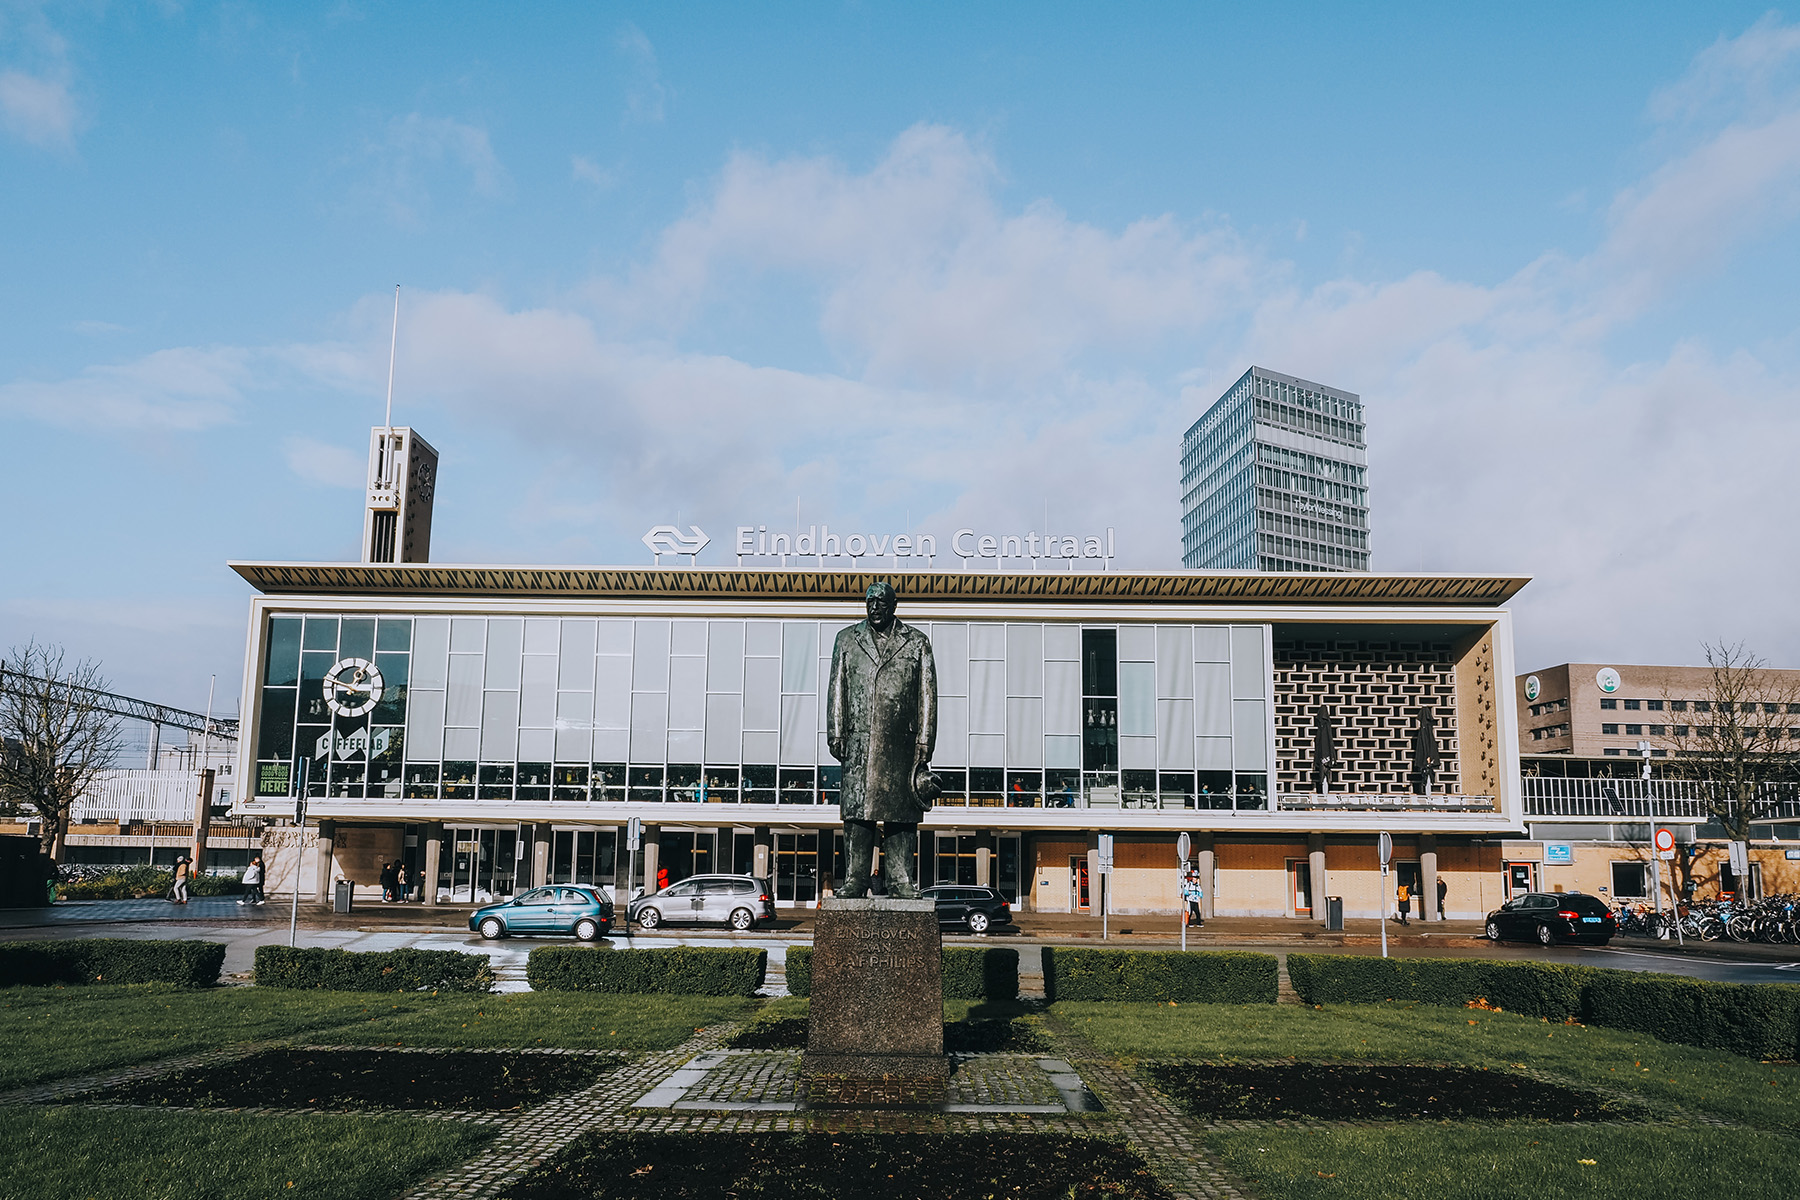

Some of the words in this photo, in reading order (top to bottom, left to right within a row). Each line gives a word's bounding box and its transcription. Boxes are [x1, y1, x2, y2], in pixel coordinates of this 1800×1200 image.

[736, 525, 936, 557] Eindhoven
[951, 527, 1115, 559] Centraal
[321, 737, 383, 750] CFFEELAB
[259, 780, 288, 792] HERE
[836, 928, 917, 940] EINDHOVEN
[862, 942, 892, 953] AAN
[869, 955, 925, 968] PHILIPS
